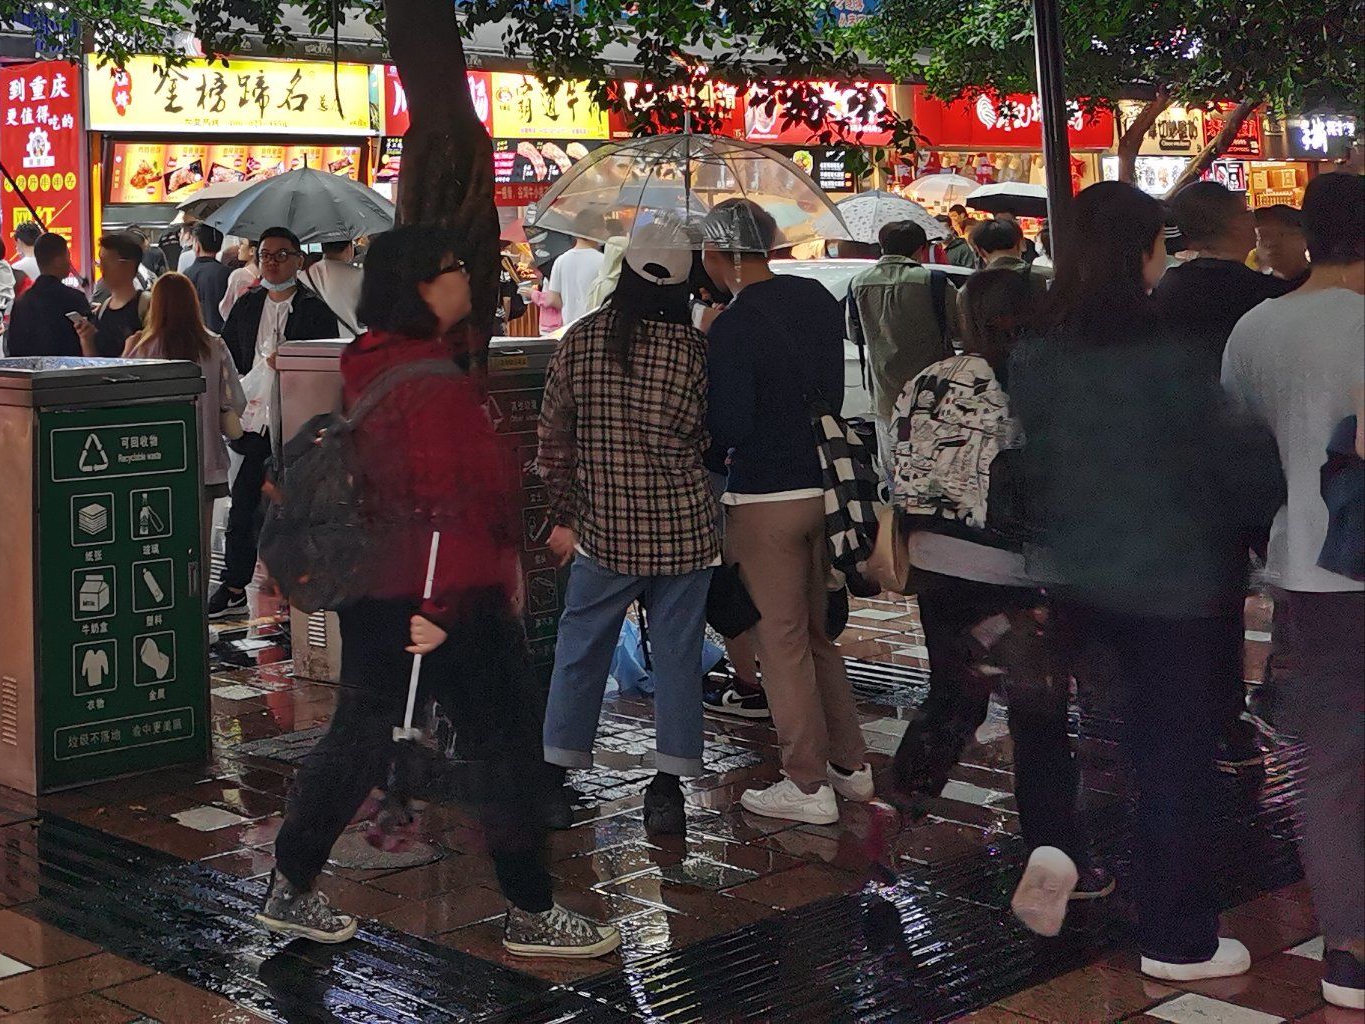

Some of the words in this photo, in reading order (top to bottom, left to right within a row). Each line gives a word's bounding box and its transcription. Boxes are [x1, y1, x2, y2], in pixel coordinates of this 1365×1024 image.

[8, 73, 70, 102] 到重庆
[5, 105, 74, 131] 更值得吃的
[120, 435, 158, 449] 可回收物
[81, 621, 109, 635] 牛奶盒
